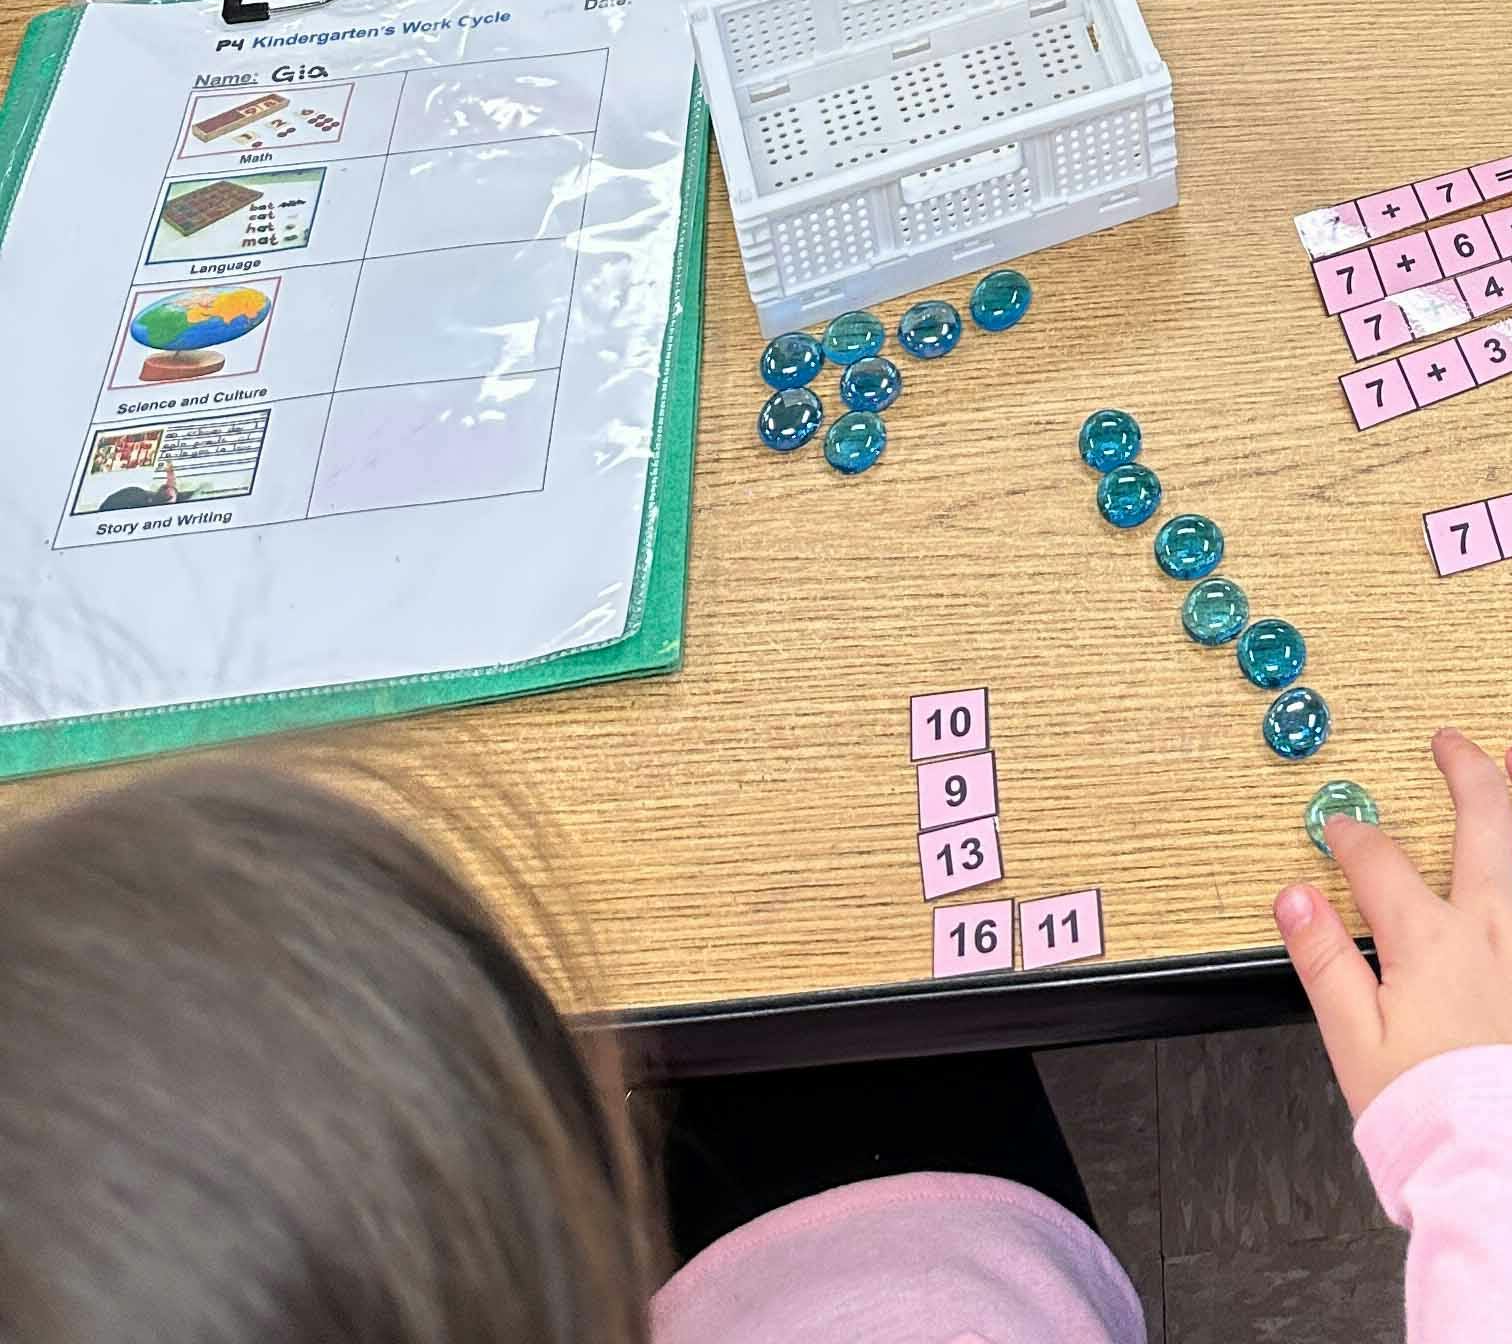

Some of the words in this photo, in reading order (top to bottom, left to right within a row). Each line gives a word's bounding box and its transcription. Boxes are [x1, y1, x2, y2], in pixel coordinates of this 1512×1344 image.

[215, 37, 244, 53] P4
[252, 23, 395, 49] Kindergarten's
[402, 15, 451, 34] Work
[457, 10, 511, 29] Cycle
[193, 71, 259, 88] Name:
[272, 64, 330, 84] Gia
[240, 152, 272, 164] Math
[1382, 203, 1400, 218] +
[1436, 182, 1454, 203] 7
[241, 234, 279, 247] mat
[190, 259, 261, 274] Language
[1336, 266, 1355, 295] 7
[1397, 254, 1416, 273] +
[1453, 233, 1475, 258] 6
[1363, 314, 1383, 341] 7
[1484, 276, 1505, 300] 4
[1365, 378, 1384, 407] 7
[1427, 363, 1447, 381] +
[1484, 338, 1507, 363] 3
[117, 400, 176, 415] Science
[180, 394, 209, 407] and
[213, 387, 268, 403] Culture
[96, 522, 139, 536] Story
[143, 516, 171, 530] and
[176, 511, 233, 527] Writing
[1450, 522, 1469, 555] 7
[926, 706, 971, 740] 10
[945, 775, 968, 807] 9
[936, 837, 984, 876] 13
[950, 919, 998, 957] 16
[1038, 909, 1081, 948] 11
